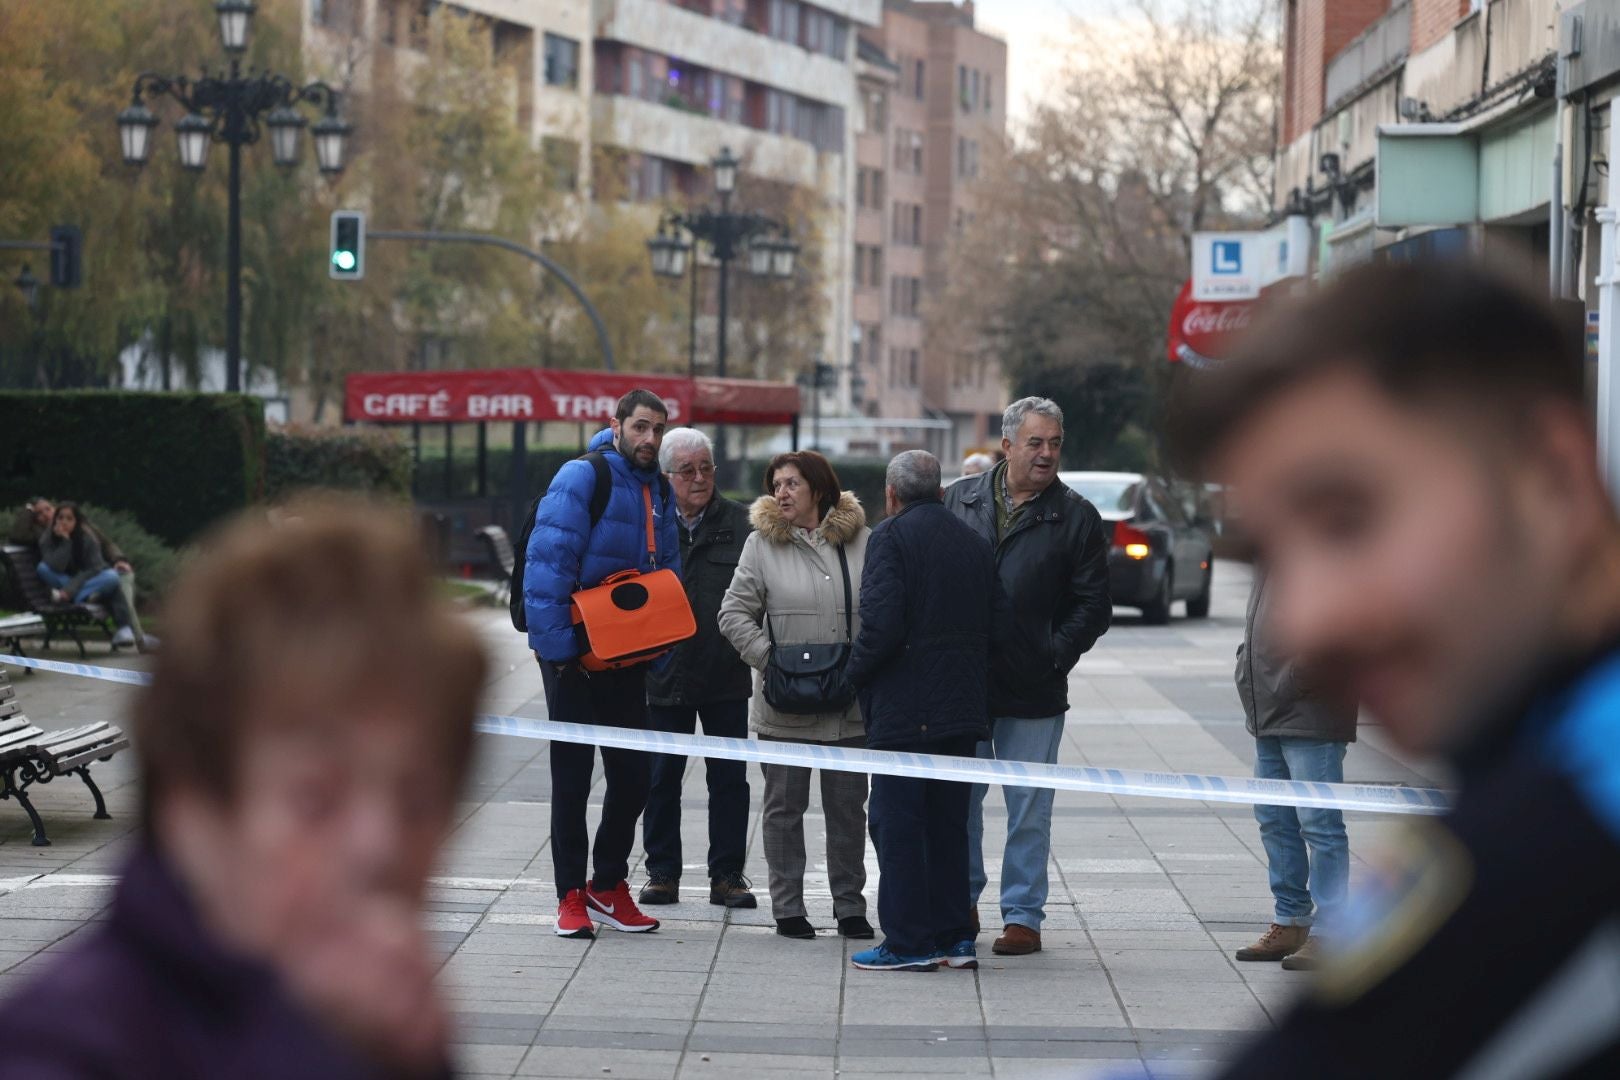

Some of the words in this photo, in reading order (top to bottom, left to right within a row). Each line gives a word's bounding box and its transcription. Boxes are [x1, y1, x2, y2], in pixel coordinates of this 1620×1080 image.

[1215, 243, 1239, 269] L
[363, 389, 450, 417] CAFÉ
[467, 395, 533, 418] BAR
[551, 395, 680, 420] TRAS
